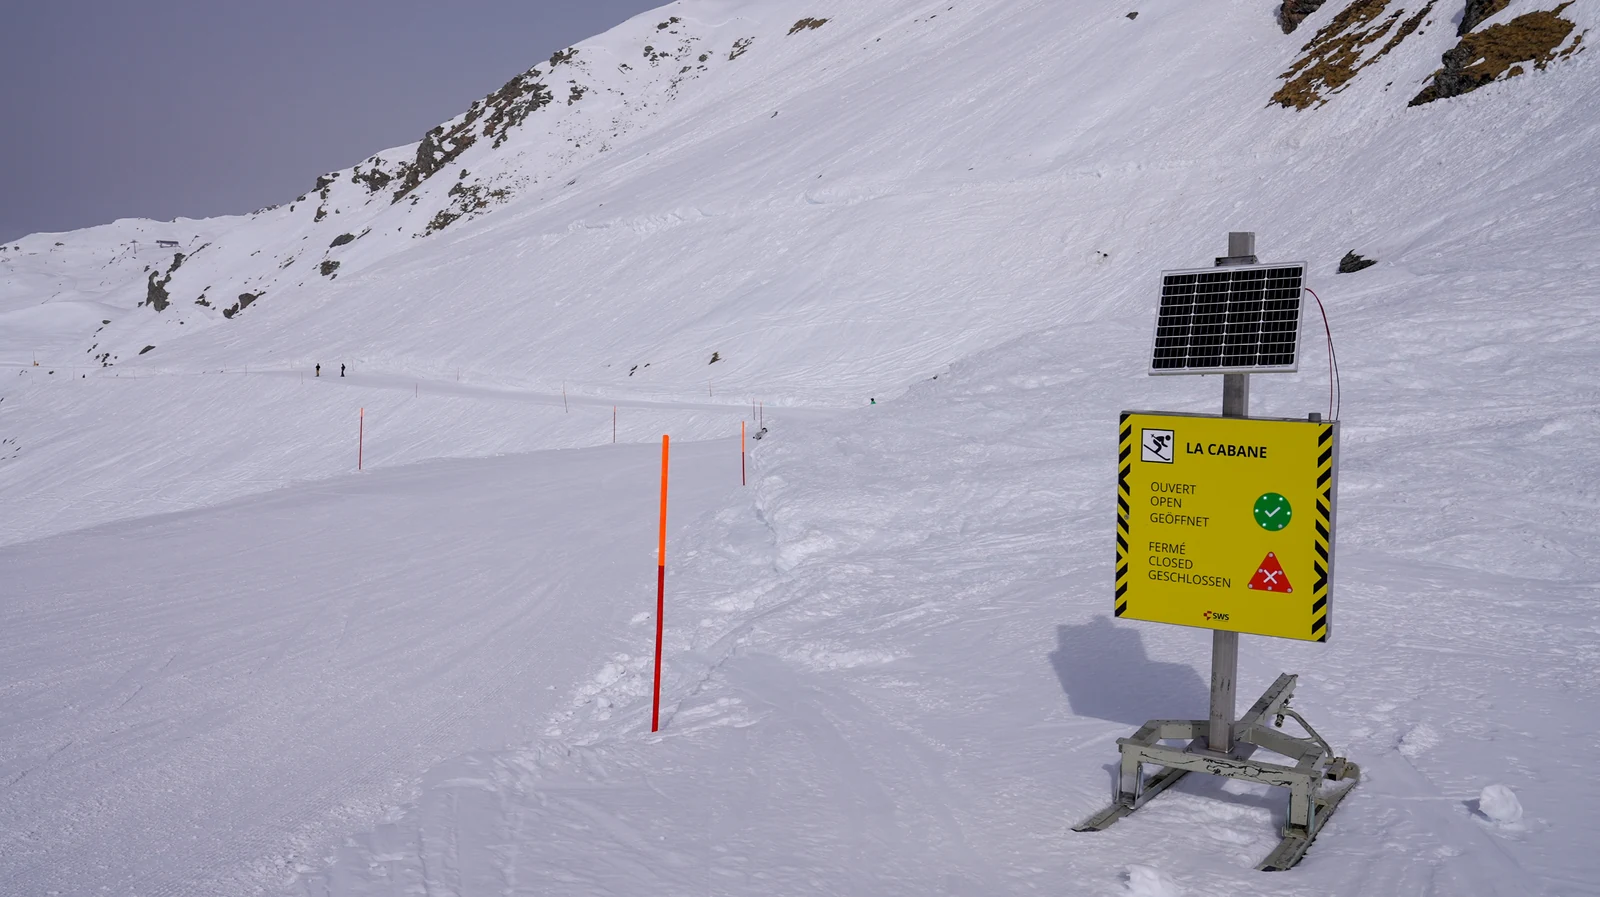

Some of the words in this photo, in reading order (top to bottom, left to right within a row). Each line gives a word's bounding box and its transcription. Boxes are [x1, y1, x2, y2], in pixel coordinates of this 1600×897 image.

[1187, 442, 1204, 455] LA
[1208, 443, 1267, 458] CABANE
[1151, 482, 1196, 494] OUVERT
[1150, 496, 1182, 508] OPEN
[1150, 512, 1209, 527] GEÖFFNET
[1149, 541, 1186, 554] FERMÉ
[1149, 556, 1193, 569] CLOSED
[1148, 570, 1231, 588] GESCHLOSSEN
[1212, 612, 1229, 620] SWS
